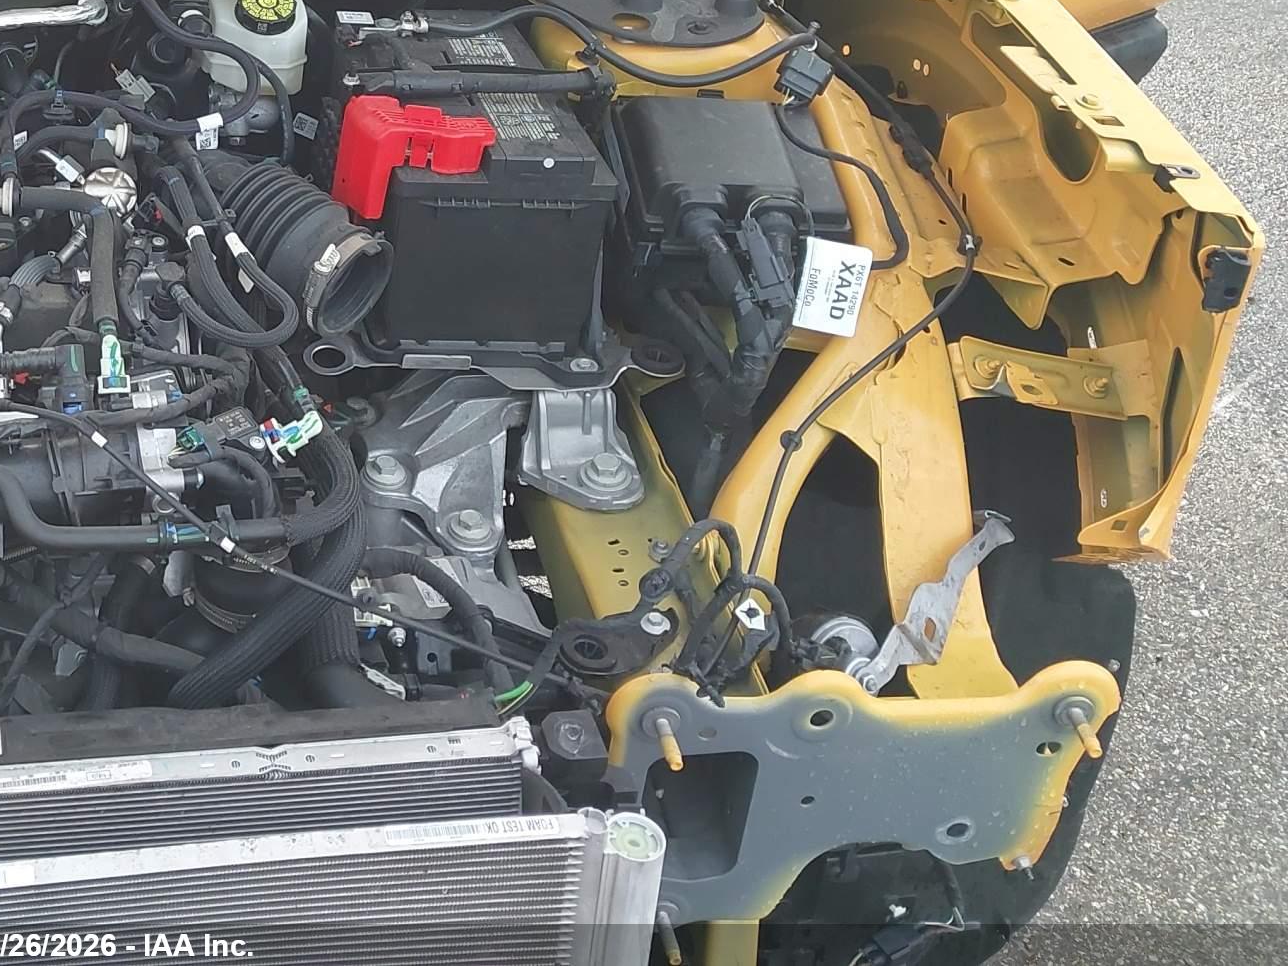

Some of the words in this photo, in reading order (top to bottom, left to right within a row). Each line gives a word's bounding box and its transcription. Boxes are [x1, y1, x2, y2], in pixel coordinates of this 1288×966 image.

[804, 268, 821, 307] FoMoCo
[829, 260, 857, 321] XAAD
[501, 815, 524, 833] TEST
[526, 813, 555, 831] FOAM
